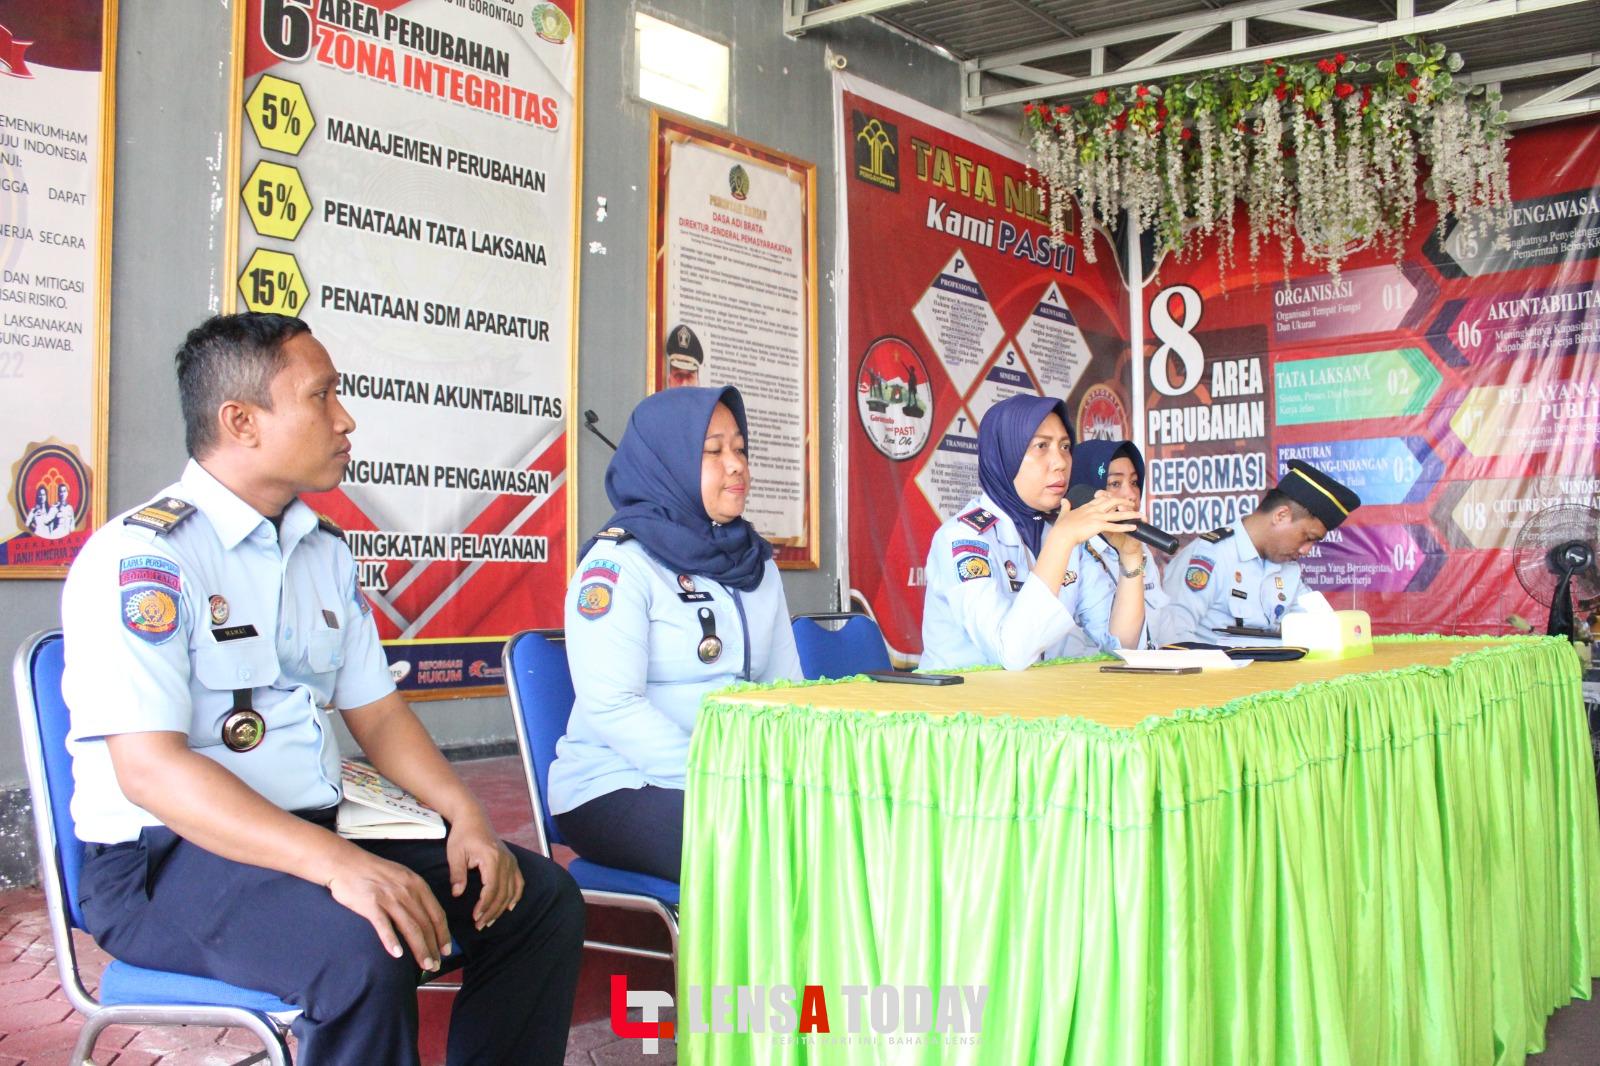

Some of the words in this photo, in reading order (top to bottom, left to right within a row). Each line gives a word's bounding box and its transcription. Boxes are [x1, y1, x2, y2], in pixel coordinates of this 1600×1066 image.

[468, 2, 524, 28] GORONTALO
[262, 0, 311, 59] 6
[318, 0, 379, 37] AREA
[384, 15, 510, 78] PERUBAHAN
[316, 27, 397, 83] ZONA
[403, 55, 559, 129] INTEGRITAS
[262, 93, 300, 136] 5%
[0, 152, 22, 167] NJI:
[24, 139, 87, 163] INDONESIA
[327, 118, 442, 168] MANAJEMEN
[447, 148, 546, 193] PERUBAHAN
[911, 138, 996, 207] TATA
[0, 179, 29, 195] GGA
[48, 187, 86, 206] DAPAT
[257, 180, 297, 222] 5%
[324, 200, 421, 240] PENATAAN
[427, 222, 467, 251] TATA
[471, 231, 547, 266] LAKSANA
[678, 217, 709, 233] DIREKTUR
[710, 224, 742, 241] JENDERAL
[712, 212, 730, 225] DASA
[743, 220, 764, 234] BRATA
[927, 197, 995, 248] Kami
[998, 221, 1075, 274] PASTI
[40, 231, 86, 250] SECARA
[953, 258, 965, 273] P
[4, 270, 30, 285] DAN
[35, 275, 84, 293] MITIGASI
[249, 268, 297, 310] 15%
[940, 278, 979, 295] PROFESIONAL
[29, 292, 67, 310] RISIKO.
[1047, 289, 1059, 303] A
[1275, 281, 1353, 307] ORGANISASI
[1382, 283, 1405, 312] 01
[4, 314, 82, 334] LAKSANAKAN
[321, 285, 419, 322] PENATAAN
[423, 302, 461, 329] SDM
[464, 310, 550, 342] APARATUR
[1276, 310, 1311, 322] Organisasi
[1277, 322, 1291, 332] Dan
[1292, 320, 1316, 331] Ukuran
[32, 336, 74, 351] JAWAB.
[1149, 285, 1205, 396] 8
[1458, 319, 1482, 349] 06
[1006, 351, 1015, 365] S
[1212, 358, 1263, 397] AREA
[1277, 371, 1307, 388] TATA
[1310, 365, 1371, 386] LAKSANA
[1387, 368, 1409, 396] 02
[336, 373, 429, 404] ENGUATAN
[434, 384, 562, 419] AKUNTABILITAS
[894, 426, 916, 436] PASTI
[956, 417, 967, 432] T
[1149, 402, 1264, 444] PERUBAHAN
[1463, 409, 1484, 439] 07
[1279, 445, 1332, 460] PERATURAN
[345, 460, 429, 487] NGUATAN
[434, 465, 549, 494] PENGAWASAN
[1152, 455, 1265, 492] REFORMASI
[1393, 455, 1415, 484] 03
[1463, 503, 1487, 531] 08
[347, 533, 445, 559] INGKATAN
[451, 536, 546, 560] PELAYANAN
[1328, 562, 1345, 575] Yang
[1393, 543, 1416, 571] 04
[1320, 575, 1334, 585] Dan
[418, 670, 462, 684] HUKUM
